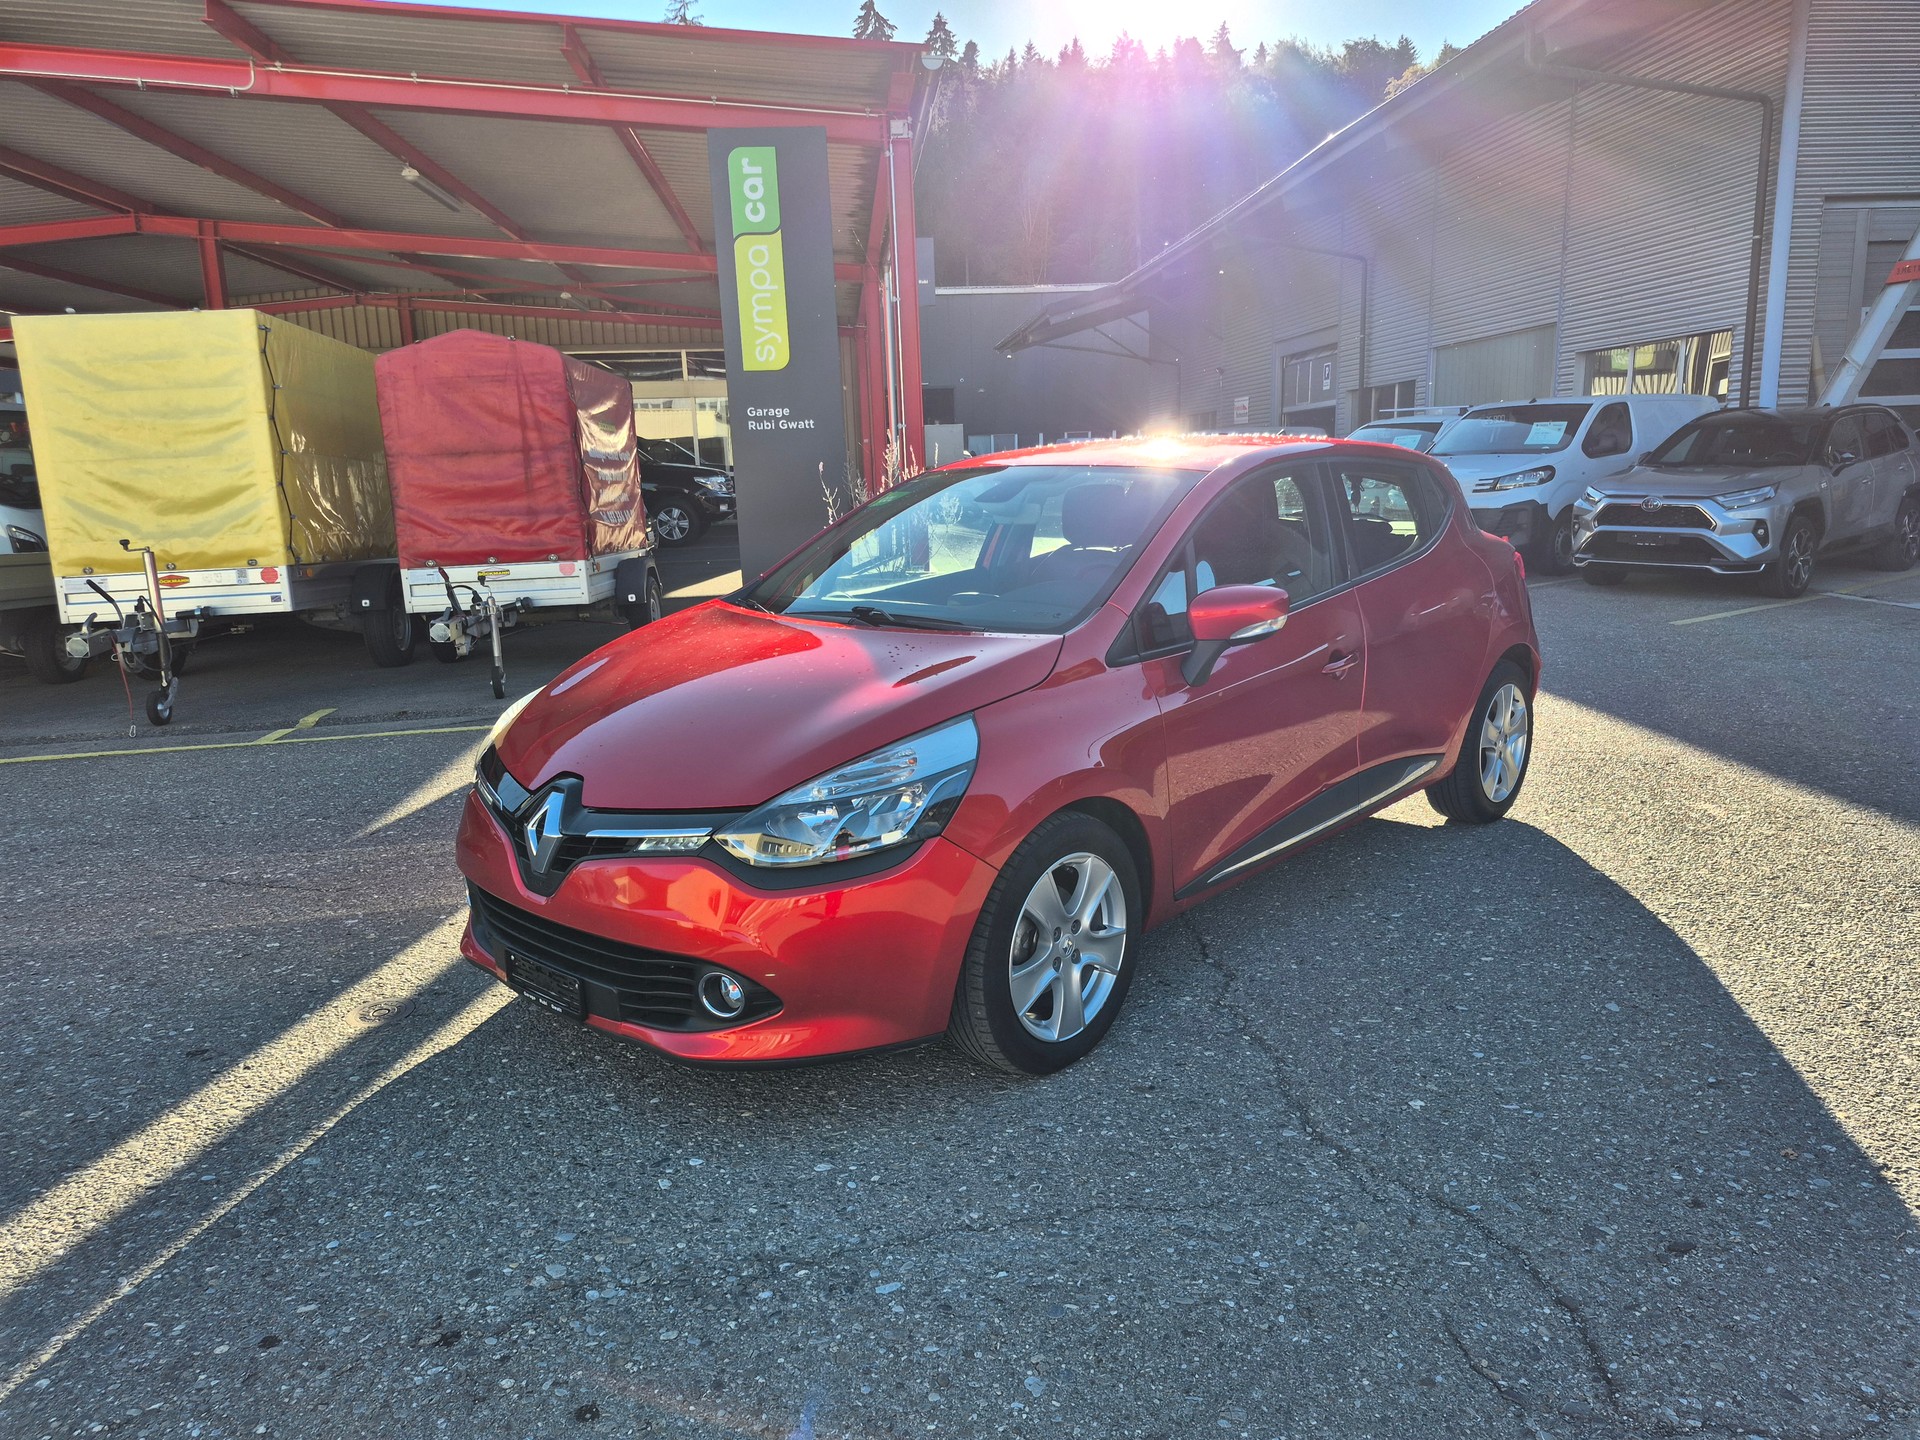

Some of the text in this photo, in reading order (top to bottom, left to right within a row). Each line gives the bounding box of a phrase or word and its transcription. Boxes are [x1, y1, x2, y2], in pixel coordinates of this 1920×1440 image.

[741, 157, 782, 363] sympa car
[747, 407, 790, 418] Garage
[748, 420, 815, 430] Rubi Gwatt
